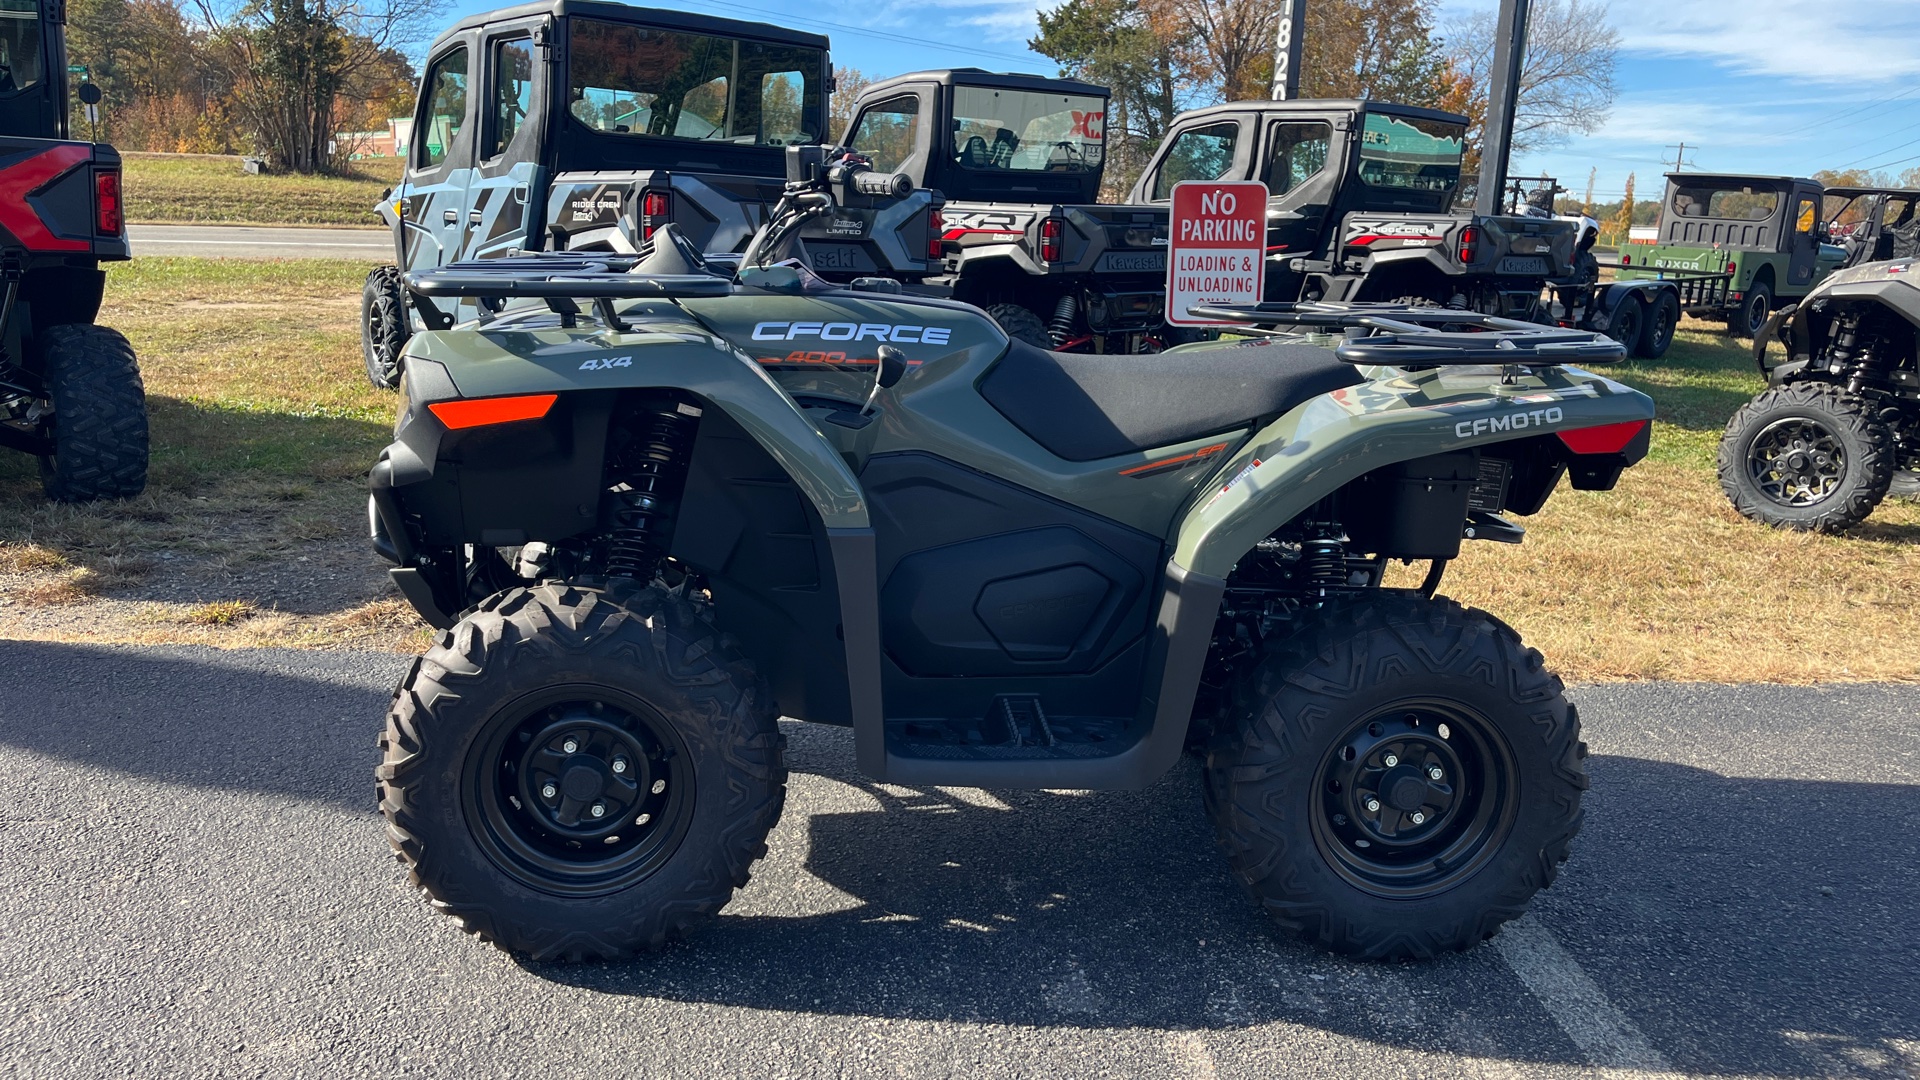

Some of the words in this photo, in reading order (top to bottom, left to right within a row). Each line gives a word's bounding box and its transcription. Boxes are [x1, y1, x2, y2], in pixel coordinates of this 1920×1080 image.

[1201, 192, 1237, 215] NO
[948, 218, 978, 226] RIDGE
[1181, 219, 1256, 242] PARKING
[1106, 254, 1165, 270] Kawasaki
[1180, 256, 1236, 272] LOADING
[1242, 256, 1252, 272] &
[1503, 259, 1543, 273] Kawasaki
[1655, 259, 1699, 270] ROXOR
[1178, 277, 1253, 293] UNLOADING
[751, 321, 951, 345] CFORCE
[785, 351, 846, 364] 400
[1455, 406, 1563, 438] CFMOTO
